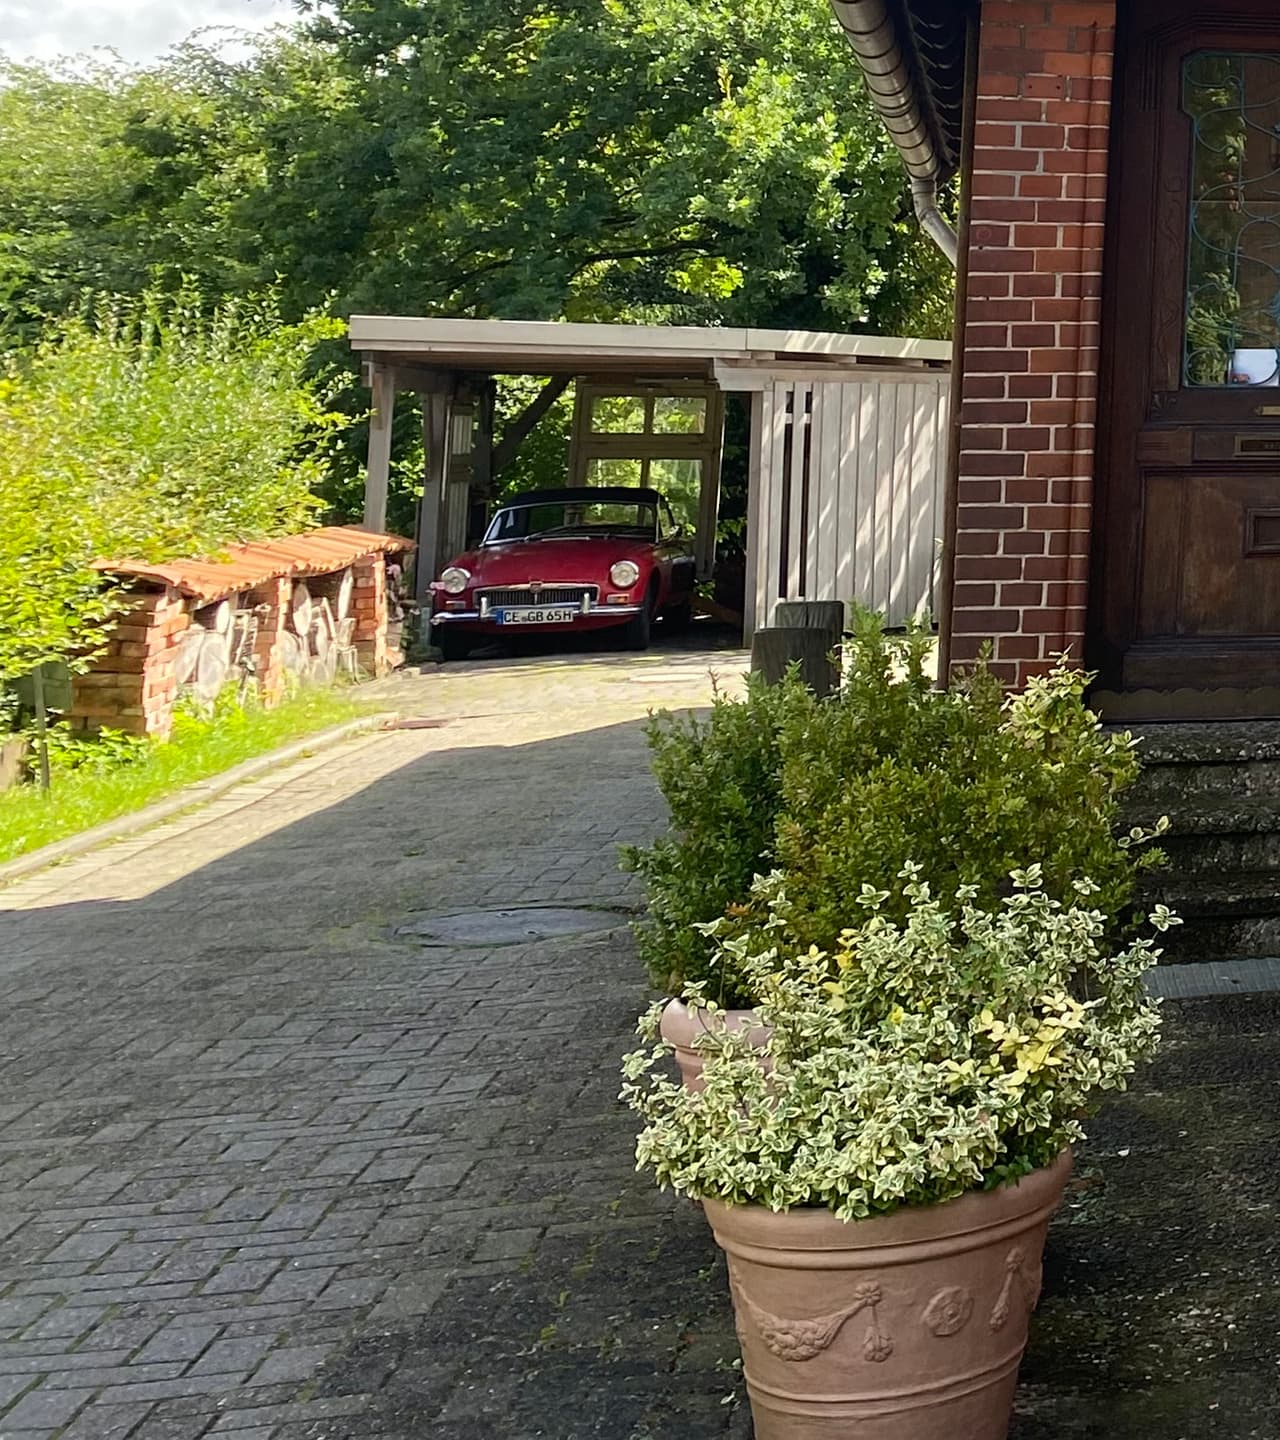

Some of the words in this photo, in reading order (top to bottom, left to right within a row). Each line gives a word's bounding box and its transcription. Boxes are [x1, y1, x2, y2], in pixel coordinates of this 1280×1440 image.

[503, 611, 520, 623] CE
[527, 611, 544, 622] GB
[546, 610, 571, 621] 65H
